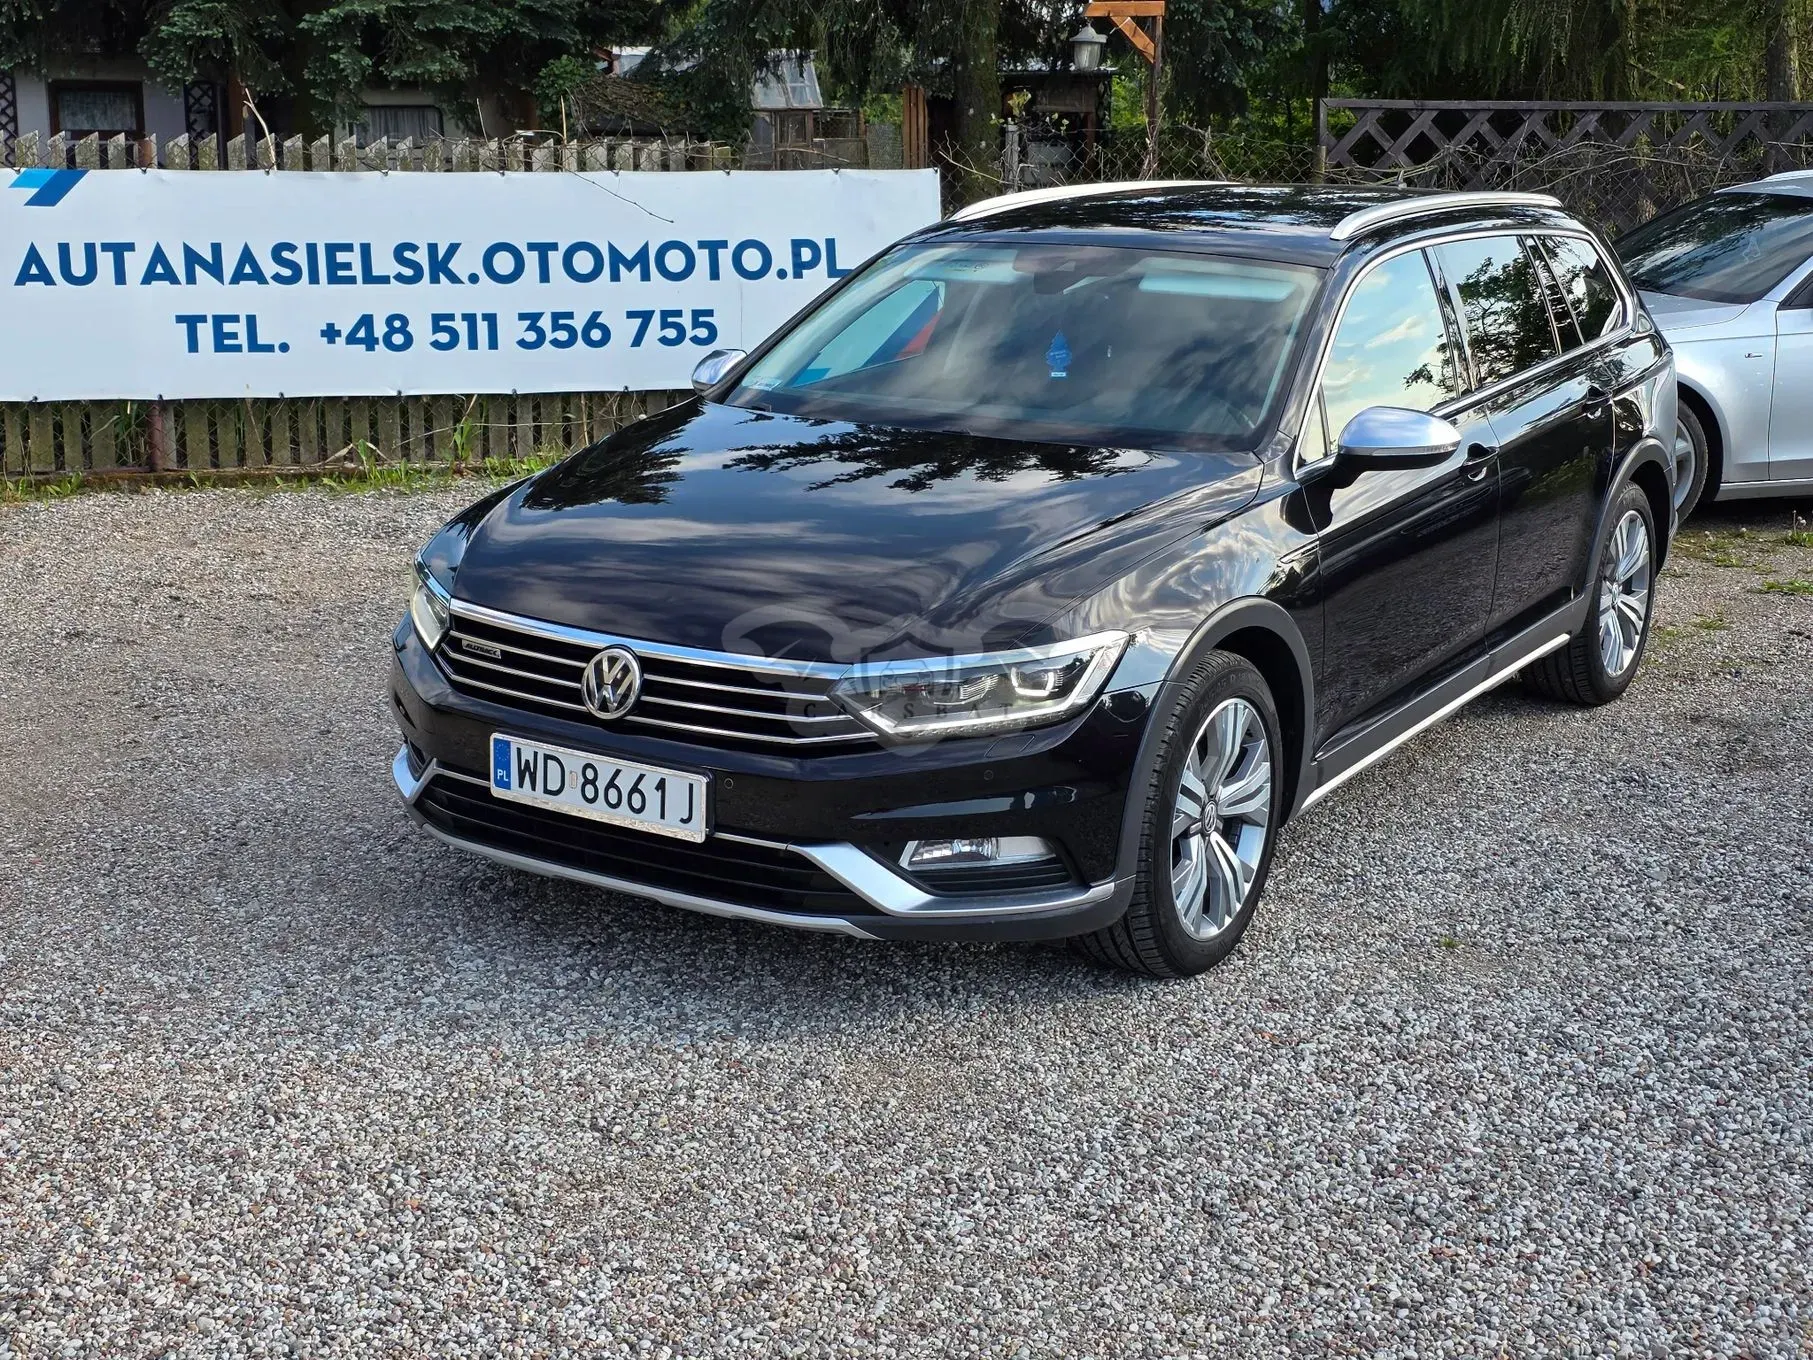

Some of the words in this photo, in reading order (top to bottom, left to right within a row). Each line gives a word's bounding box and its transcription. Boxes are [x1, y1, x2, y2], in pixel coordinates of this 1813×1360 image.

[14, 238, 854, 287] AUTANASIELSK.OTOMOTO.PL
[175, 314, 290, 354] TEL.
[320, 313, 413, 353] +48
[430, 312, 498, 352] 511
[516, 311, 611, 350] 356
[626, 309, 719, 348] 755
[497, 768, 509, 781] PL
[516, 747, 566, 797] WD
